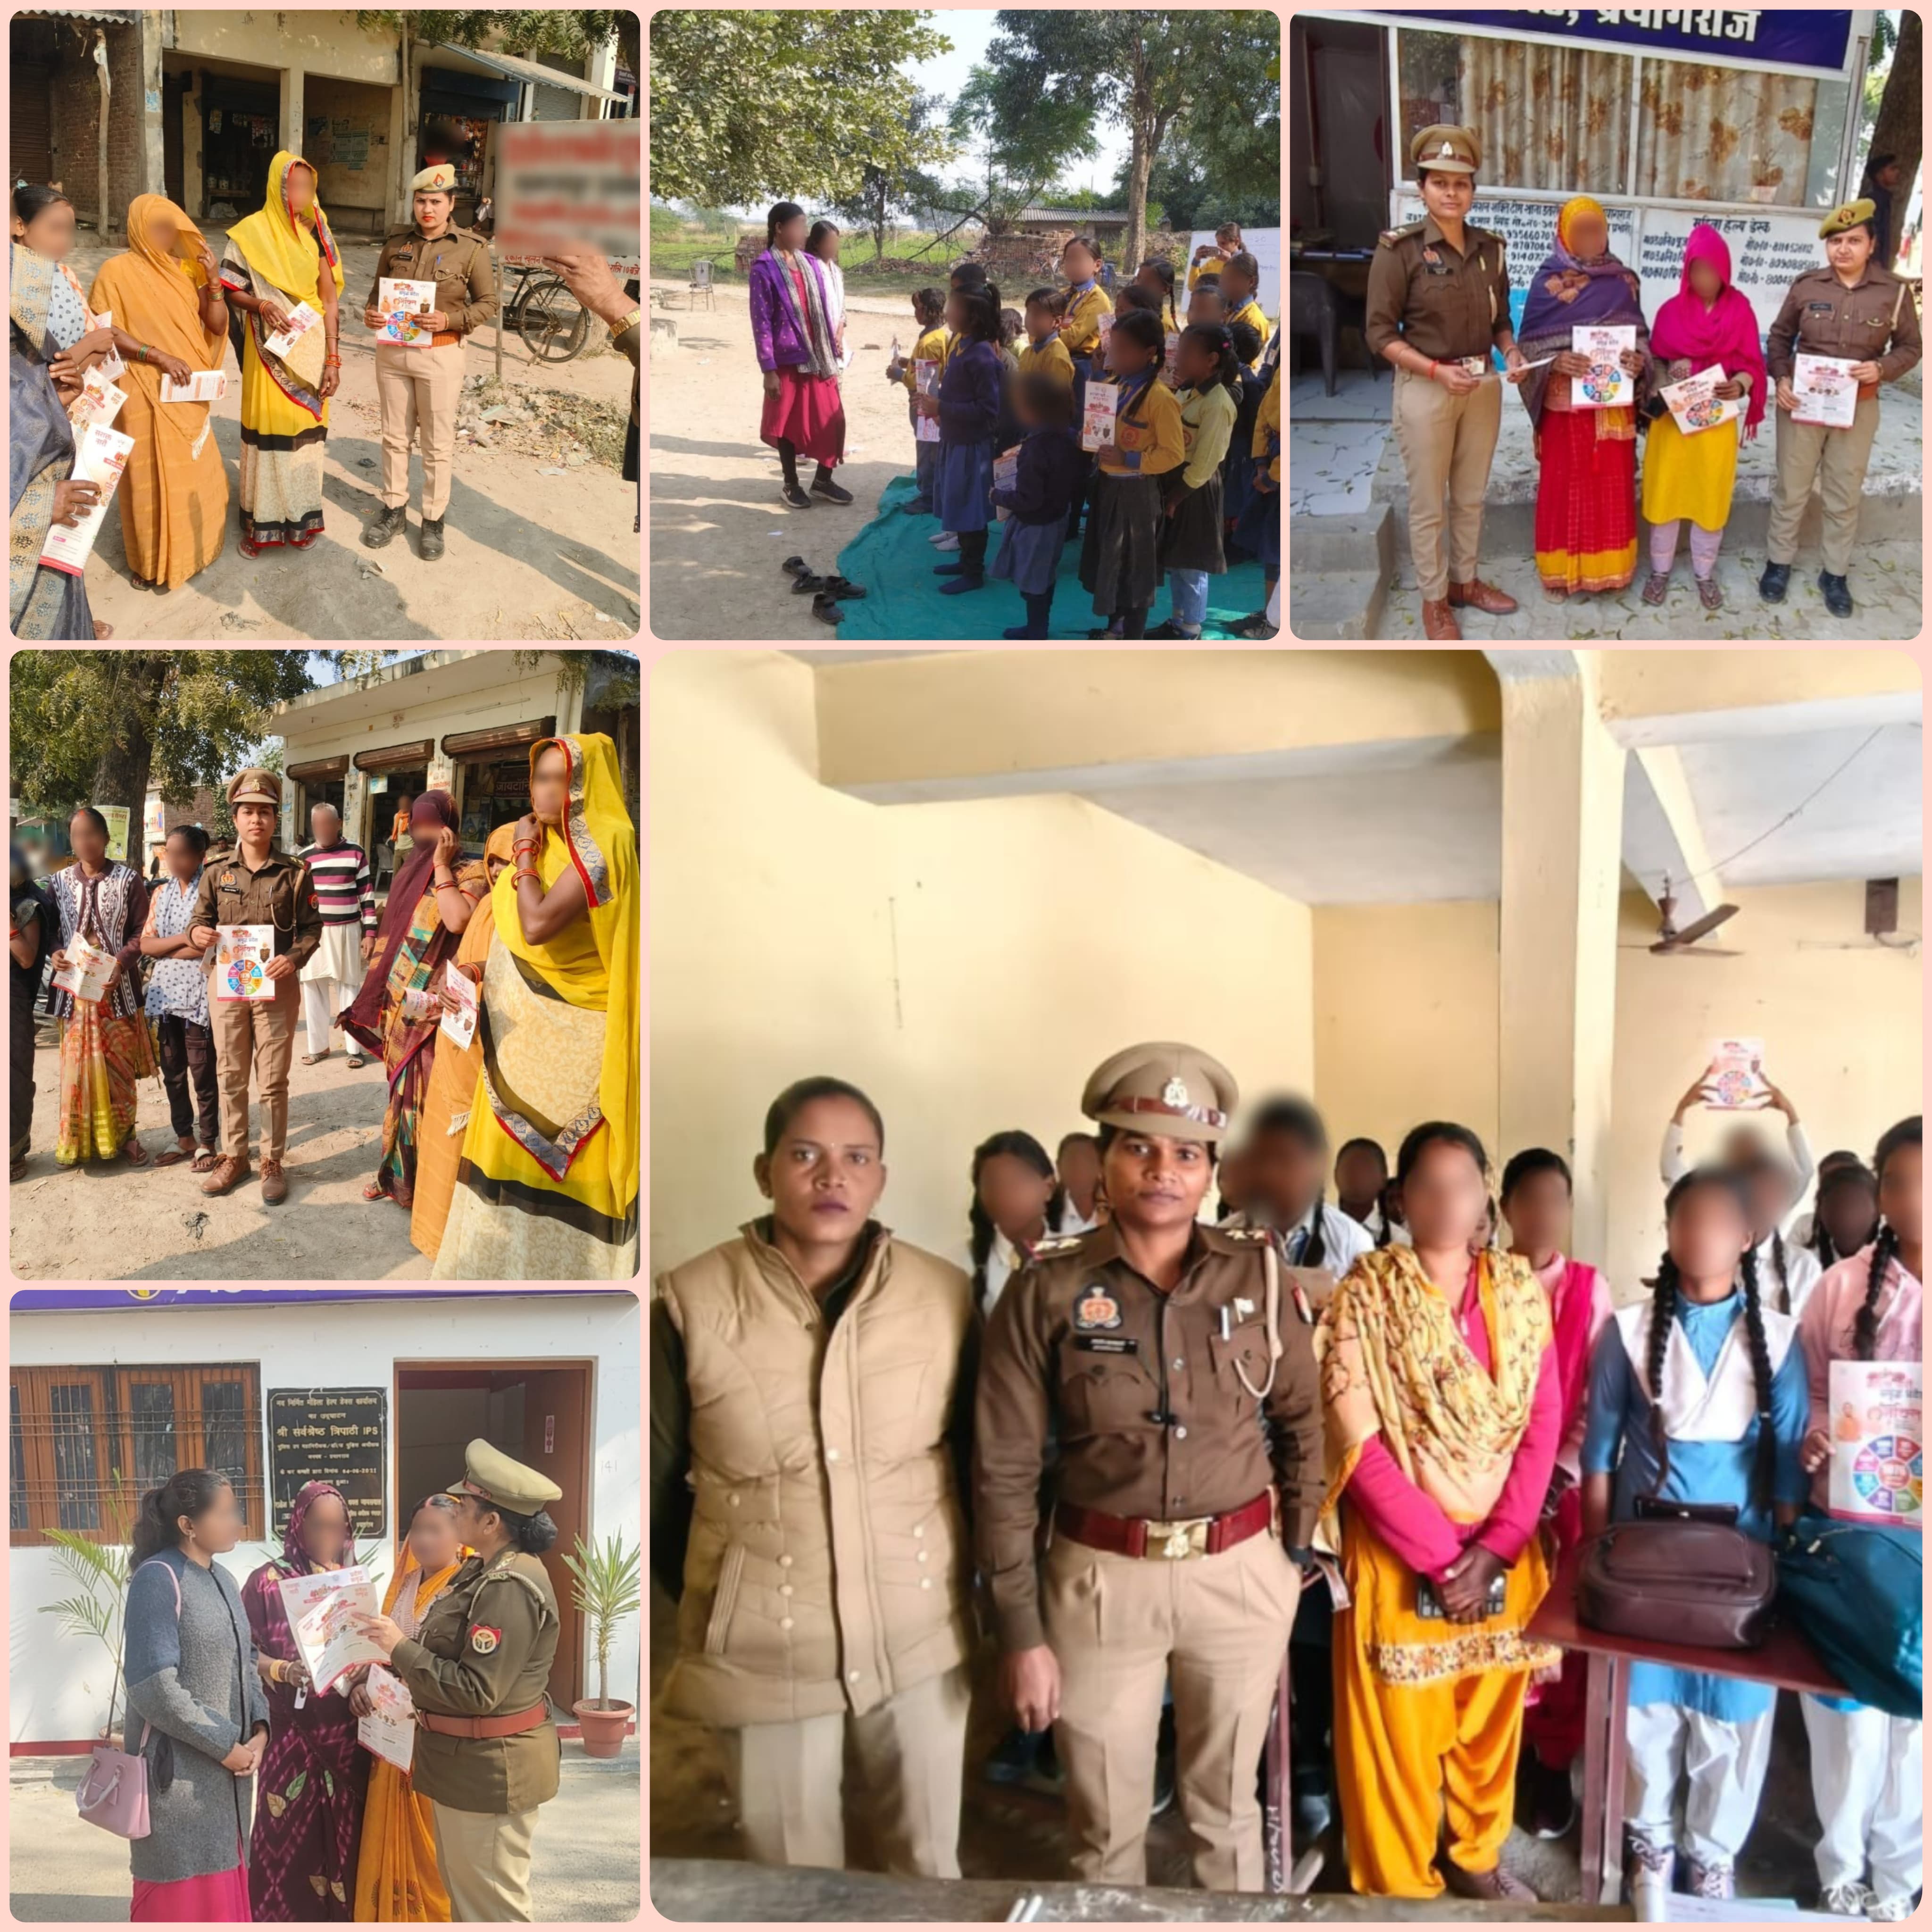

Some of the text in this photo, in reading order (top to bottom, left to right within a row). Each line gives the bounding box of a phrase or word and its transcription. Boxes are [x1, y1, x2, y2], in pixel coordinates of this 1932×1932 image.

[277, 1424, 378, 1437] श्री सर्वश्रेष्ठ त्रिपाठी IPS
